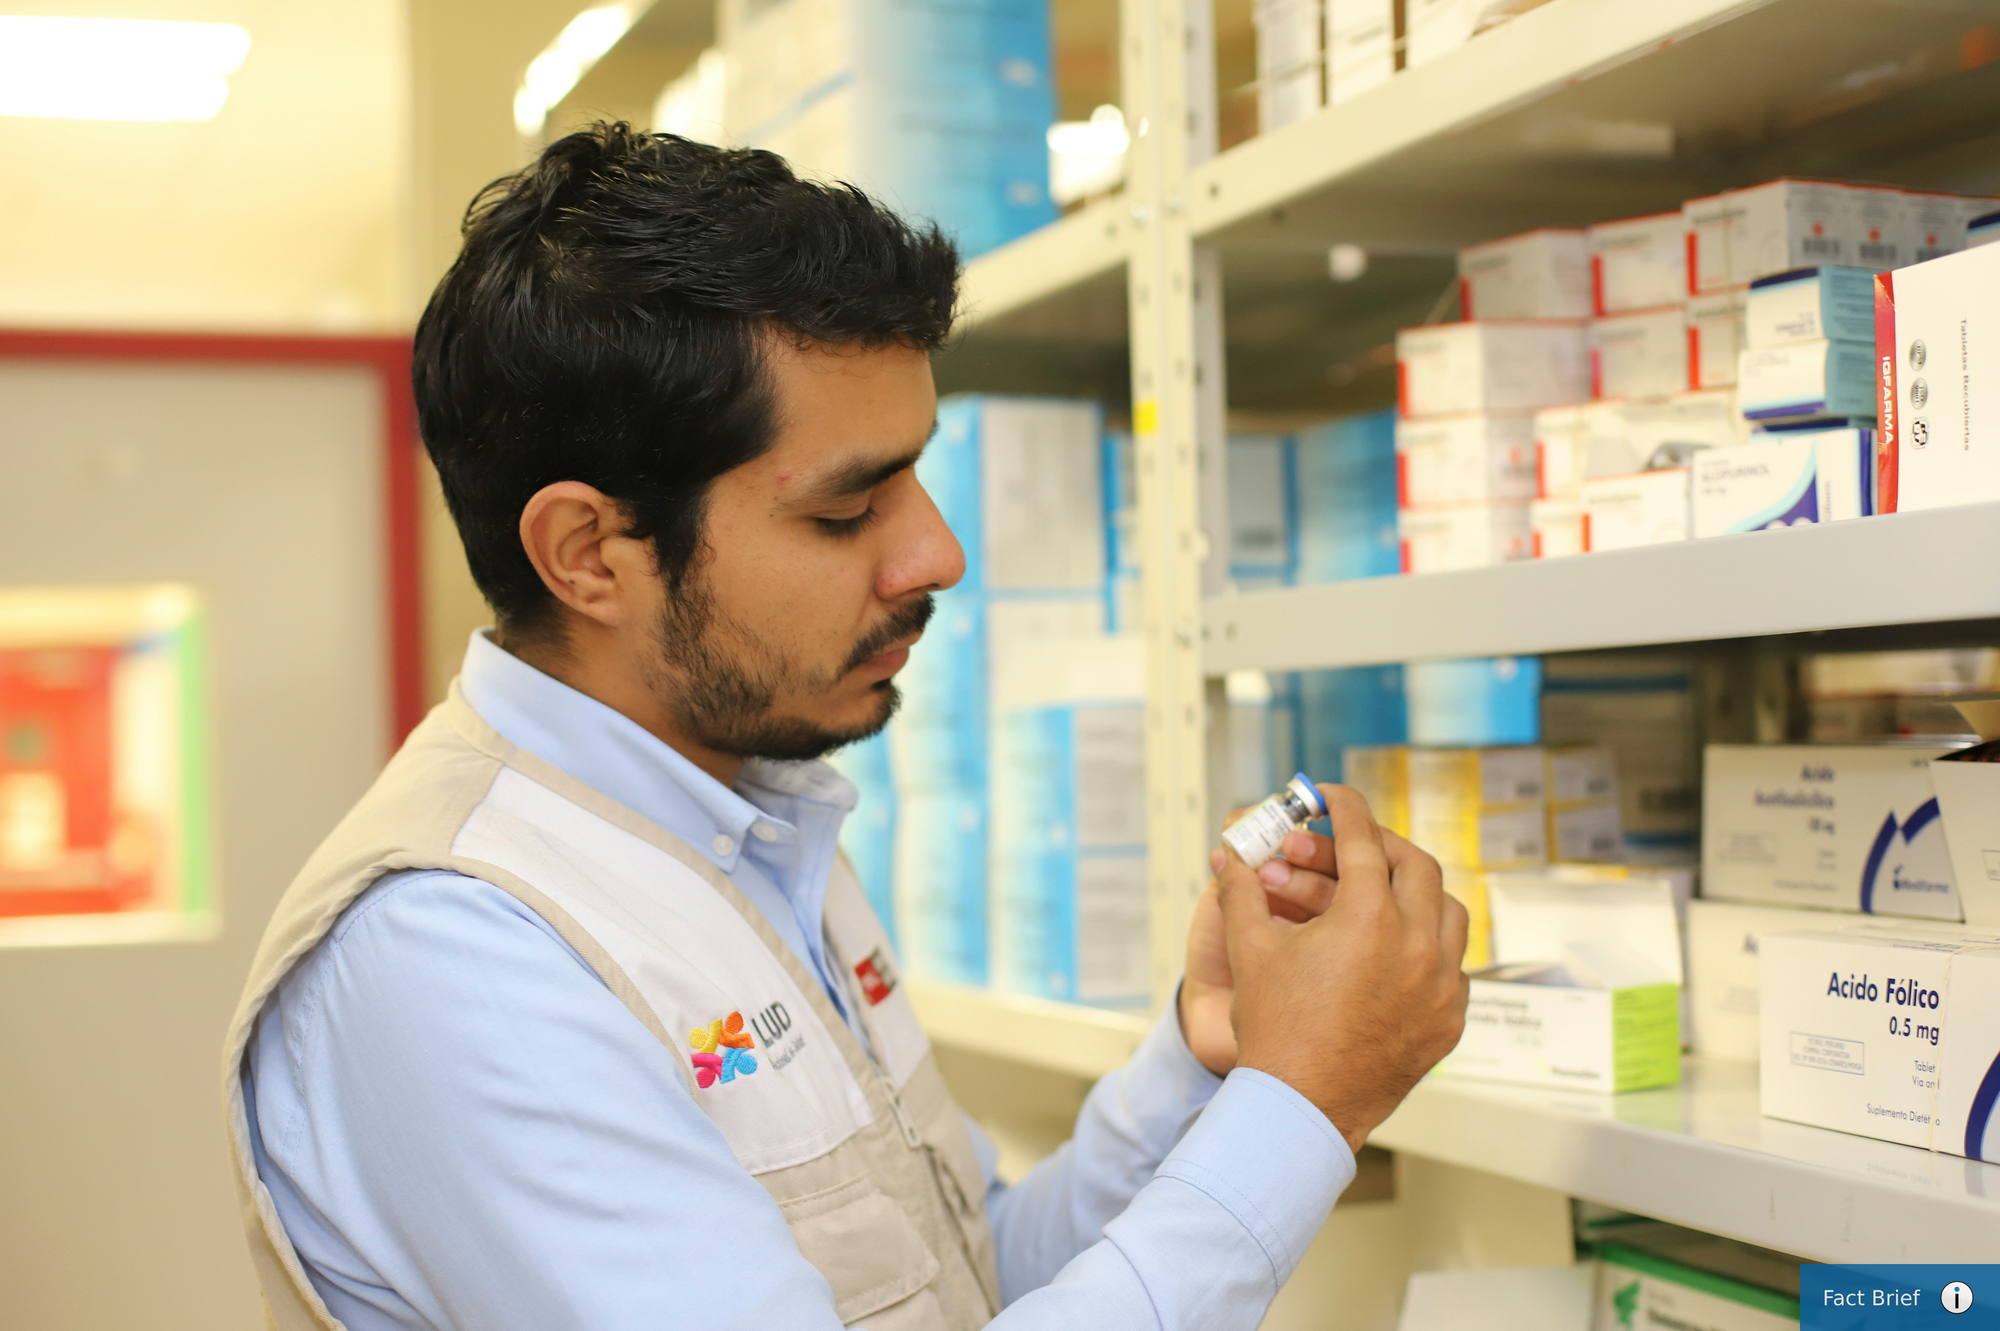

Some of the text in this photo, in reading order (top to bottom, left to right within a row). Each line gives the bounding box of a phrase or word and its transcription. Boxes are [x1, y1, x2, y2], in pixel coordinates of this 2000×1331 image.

[1960, 318, 1971, 451] Tabletas Recubiertas
[1827, 972, 1940, 1010] Acido Fólico
[1889, 1016, 1940, 1046] 0.5 mg
[1914, 1060, 1936, 1073] Tablet
[1925, 1078, 1940, 1090] orl
[1866, 1103, 1941, 1126] Suplemento Dietéto
